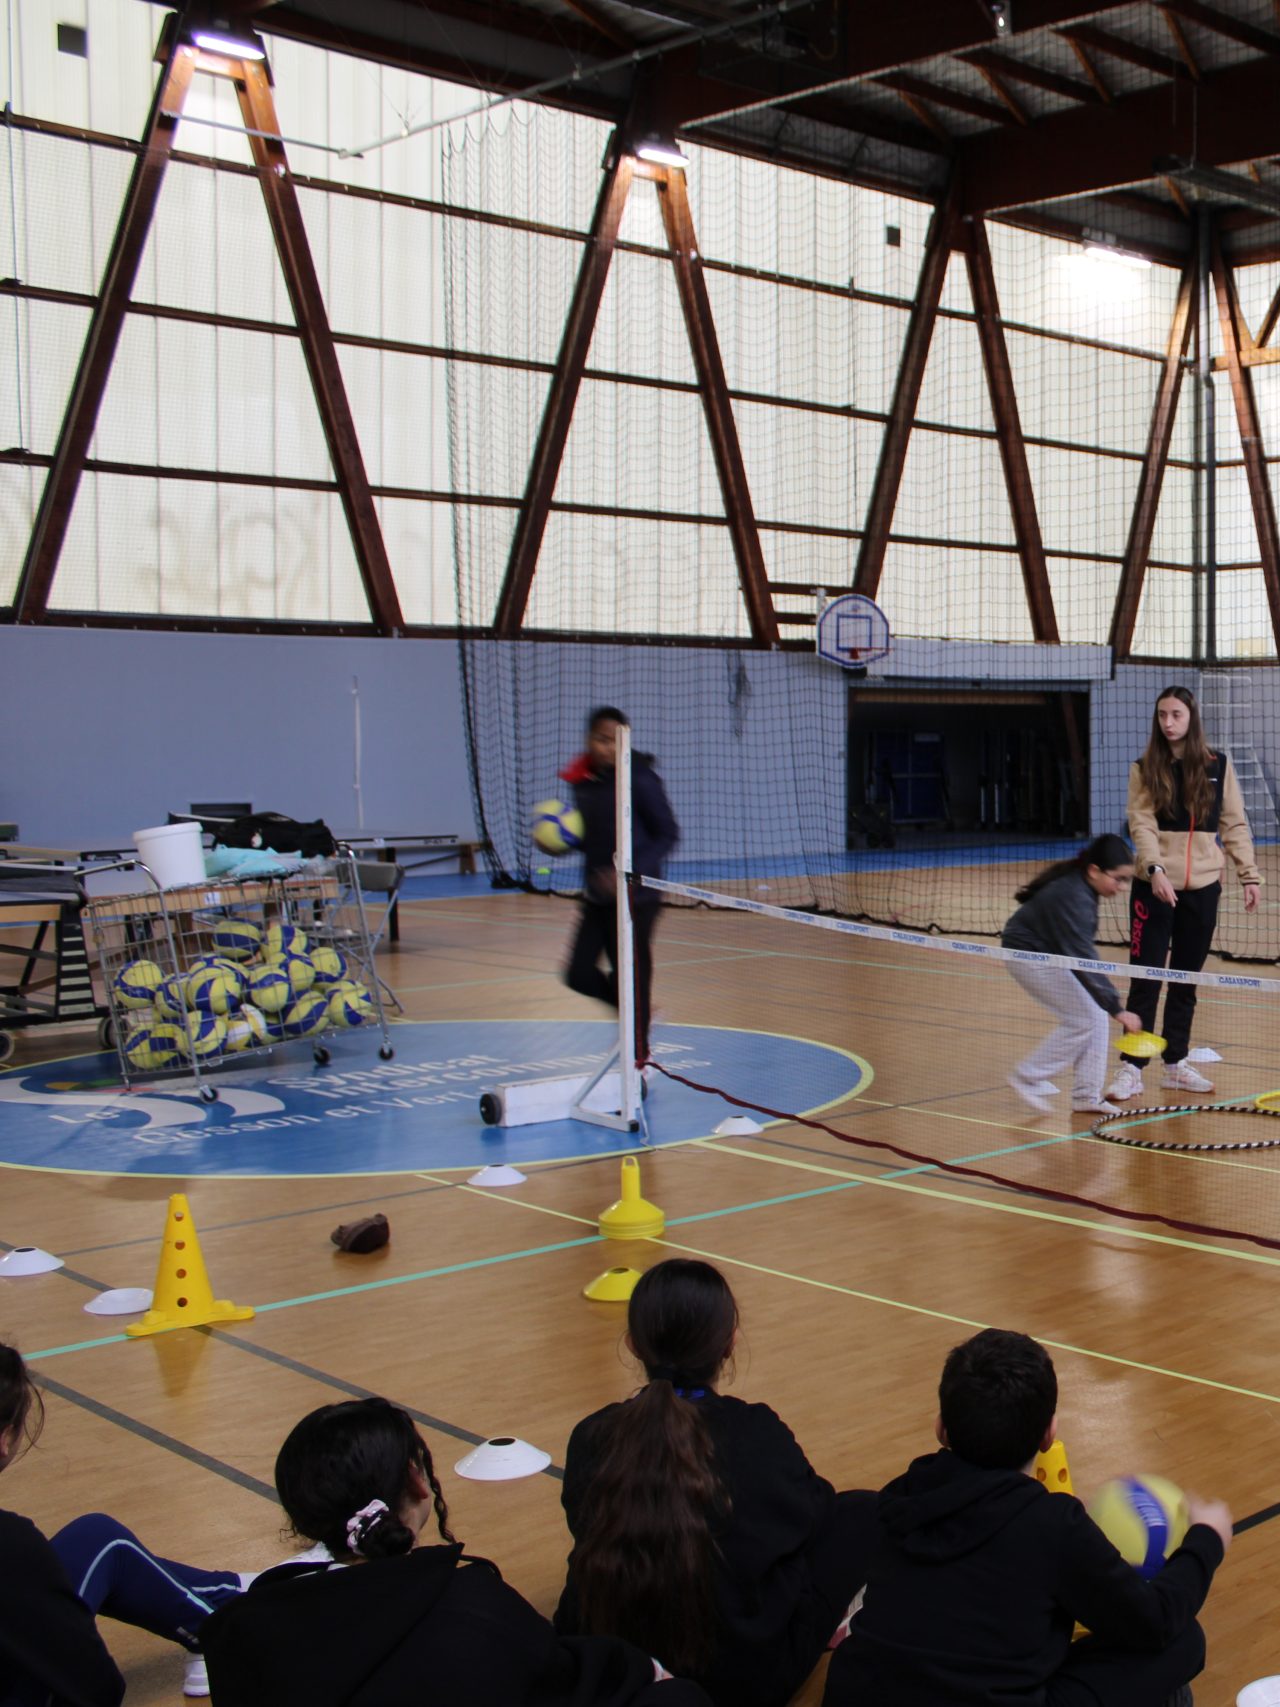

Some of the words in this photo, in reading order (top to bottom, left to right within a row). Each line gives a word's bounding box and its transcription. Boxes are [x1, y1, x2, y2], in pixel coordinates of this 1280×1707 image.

[1131, 918, 1144, 957] asics
[1078, 960, 1117, 971] CASALSPORT
[1146, 969, 1188, 980] CASALSPORT
[267, 1053, 508, 1090] Syndicat
[47, 1110, 121, 1124] Le
[325, 1105, 381, 1118] et
